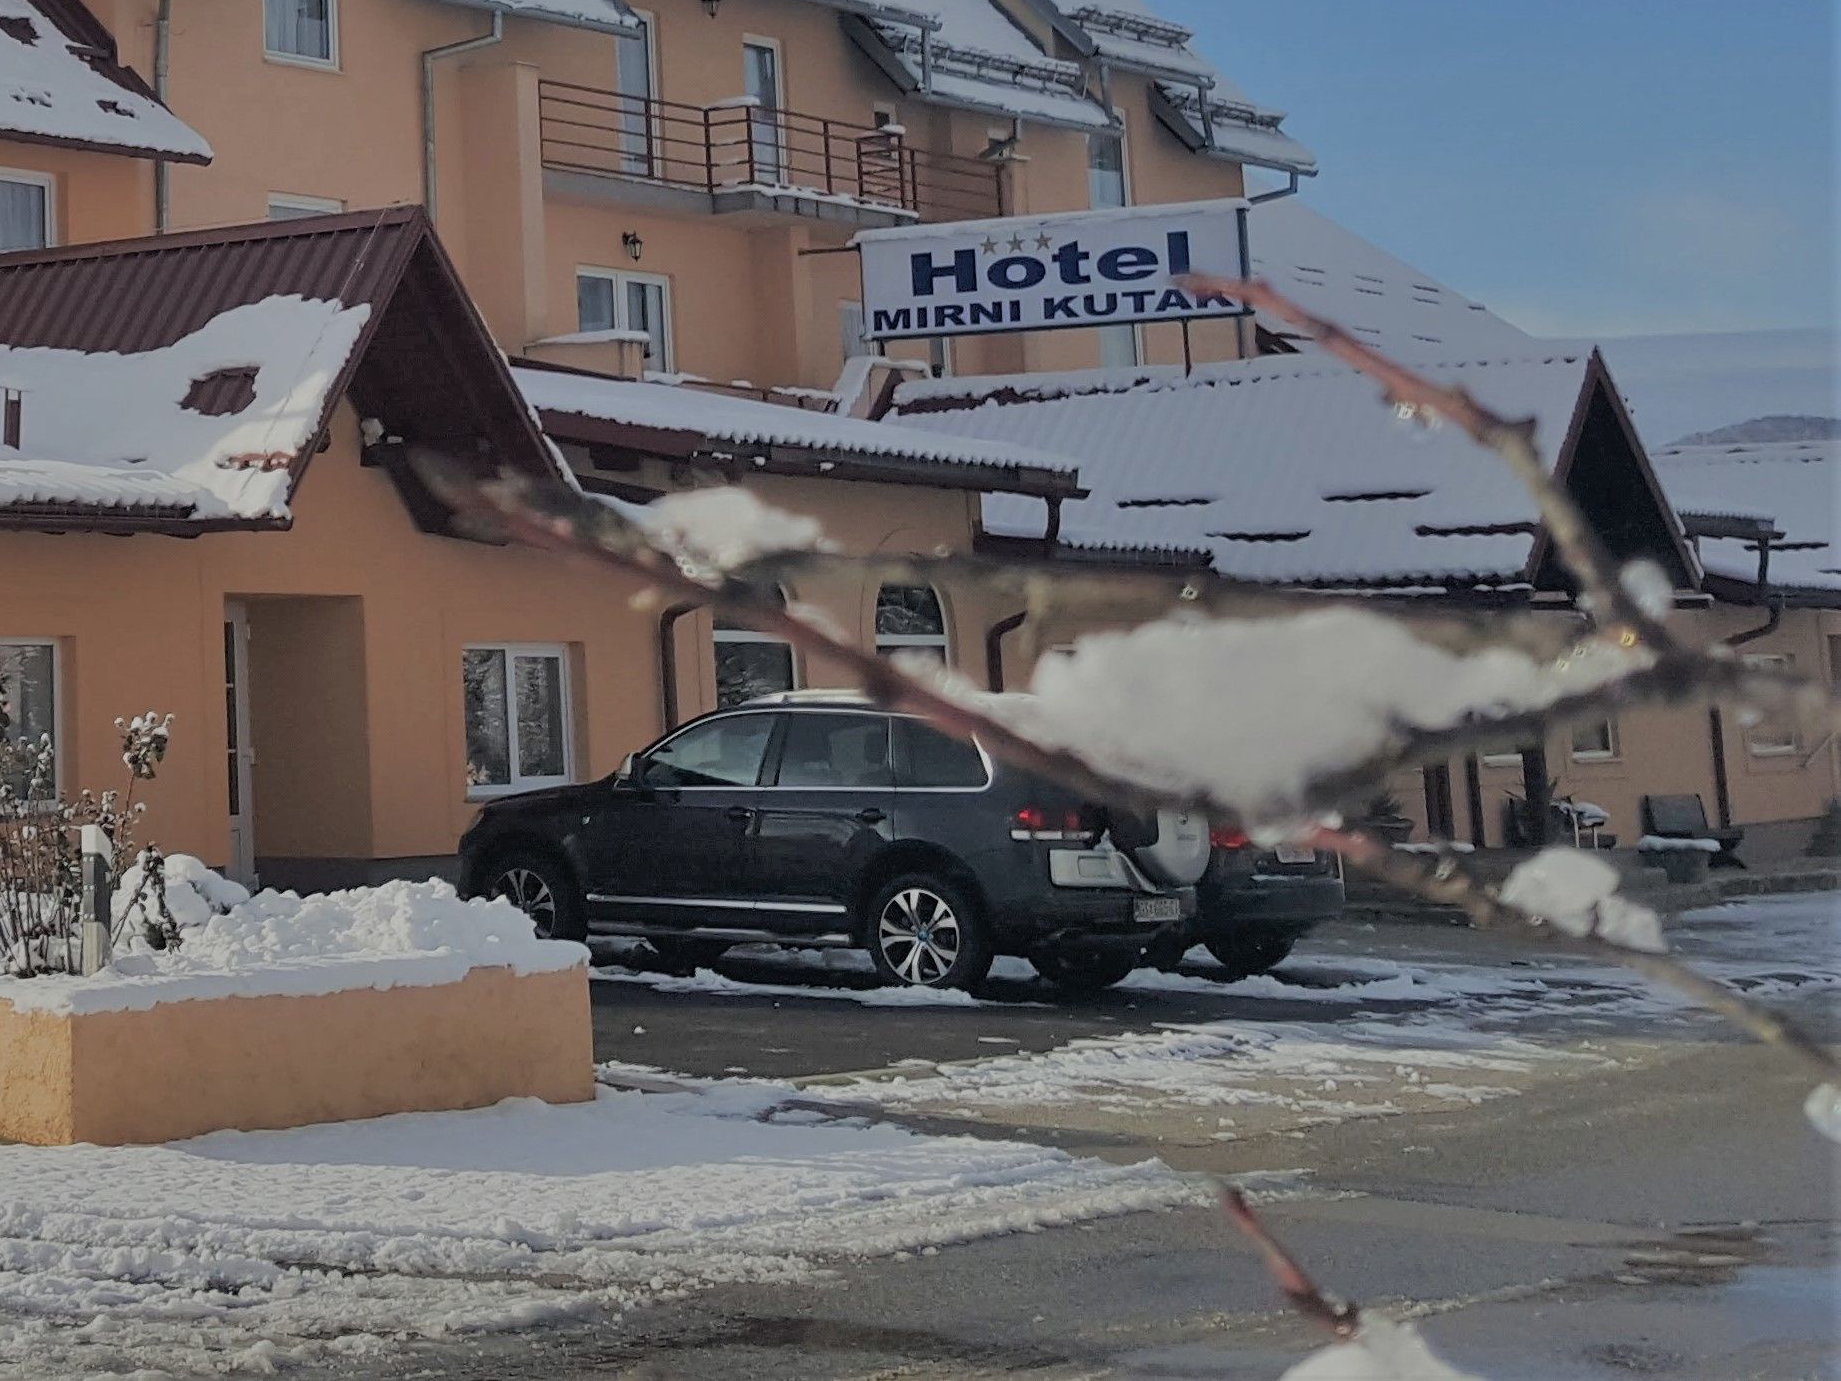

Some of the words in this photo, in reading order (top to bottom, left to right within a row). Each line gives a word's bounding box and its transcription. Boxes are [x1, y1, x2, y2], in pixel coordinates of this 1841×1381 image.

[910, 230, 1191, 297] Hotel
[872, 300, 1022, 332] MIRNI
[1043, 288, 1235, 320] KUTAK
